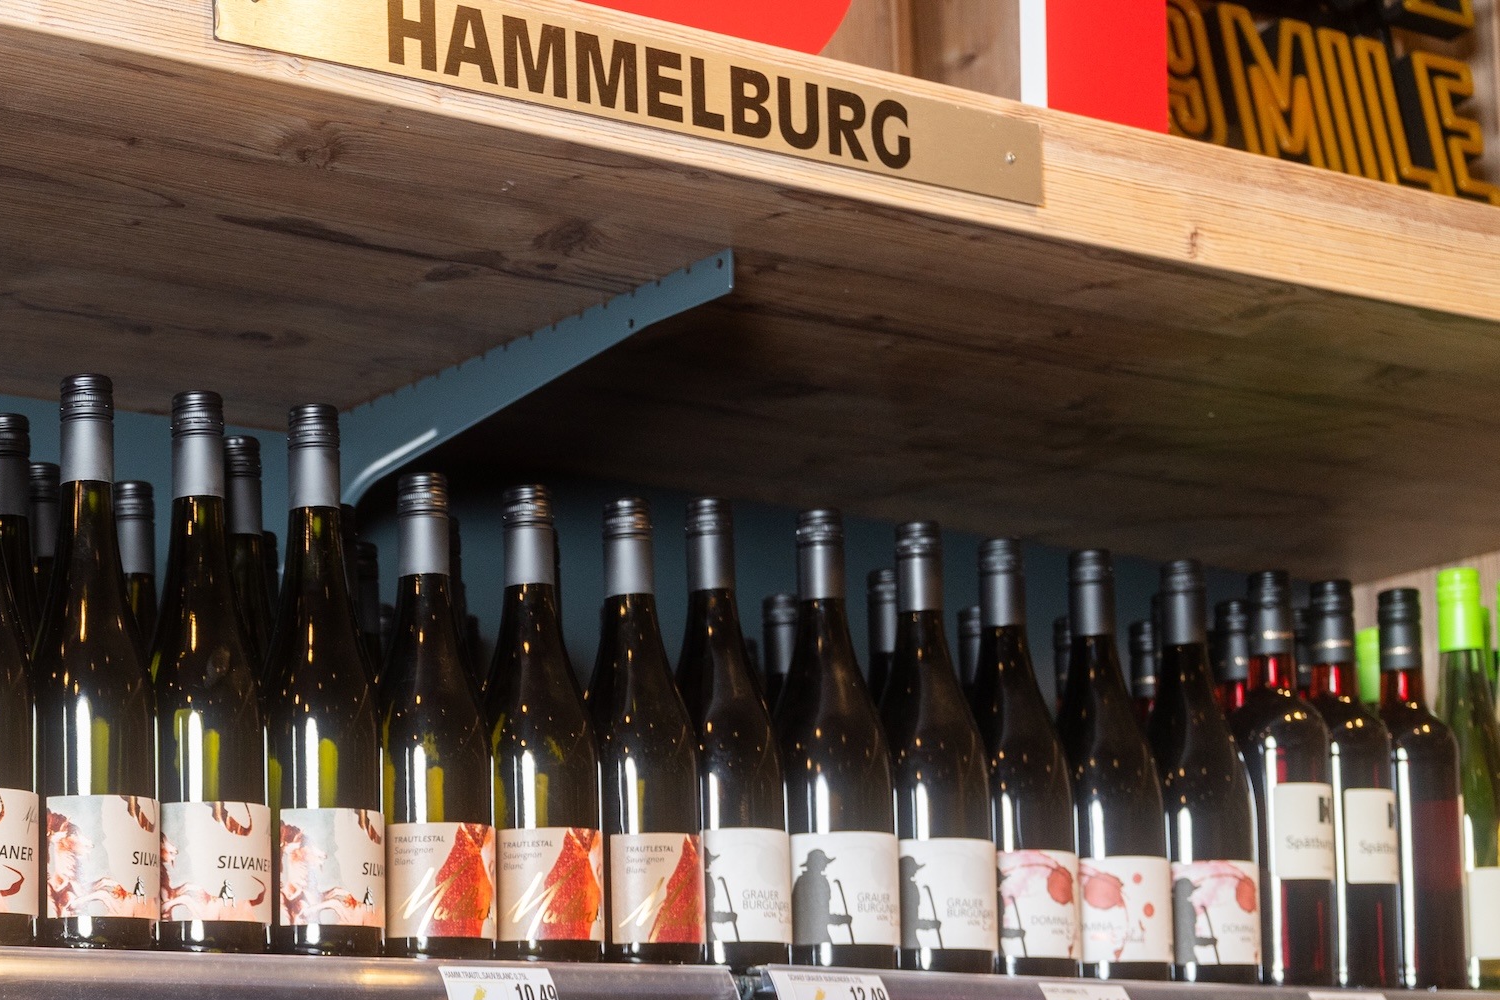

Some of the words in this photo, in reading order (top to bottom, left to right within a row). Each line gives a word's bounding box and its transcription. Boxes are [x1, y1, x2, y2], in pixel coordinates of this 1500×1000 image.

[386, 0, 912, 171] HAMMELBURG
[394, 835, 445, 844] TRAUTLESTAL
[502, 840, 553, 849] TRAUTLESTAL
[394, 845, 434, 856] Sauvignon
[625, 845, 674, 854] TRAUTLESTAL
[502, 850, 542, 861] Sauvignon
[625, 854, 665, 865] Sauvignon
[394, 857, 415, 866] Blanc
[503, 861, 524, 871] Blanc
[625, 865, 647, 875] Blanc
[742, 890, 779, 901] GRAUER
